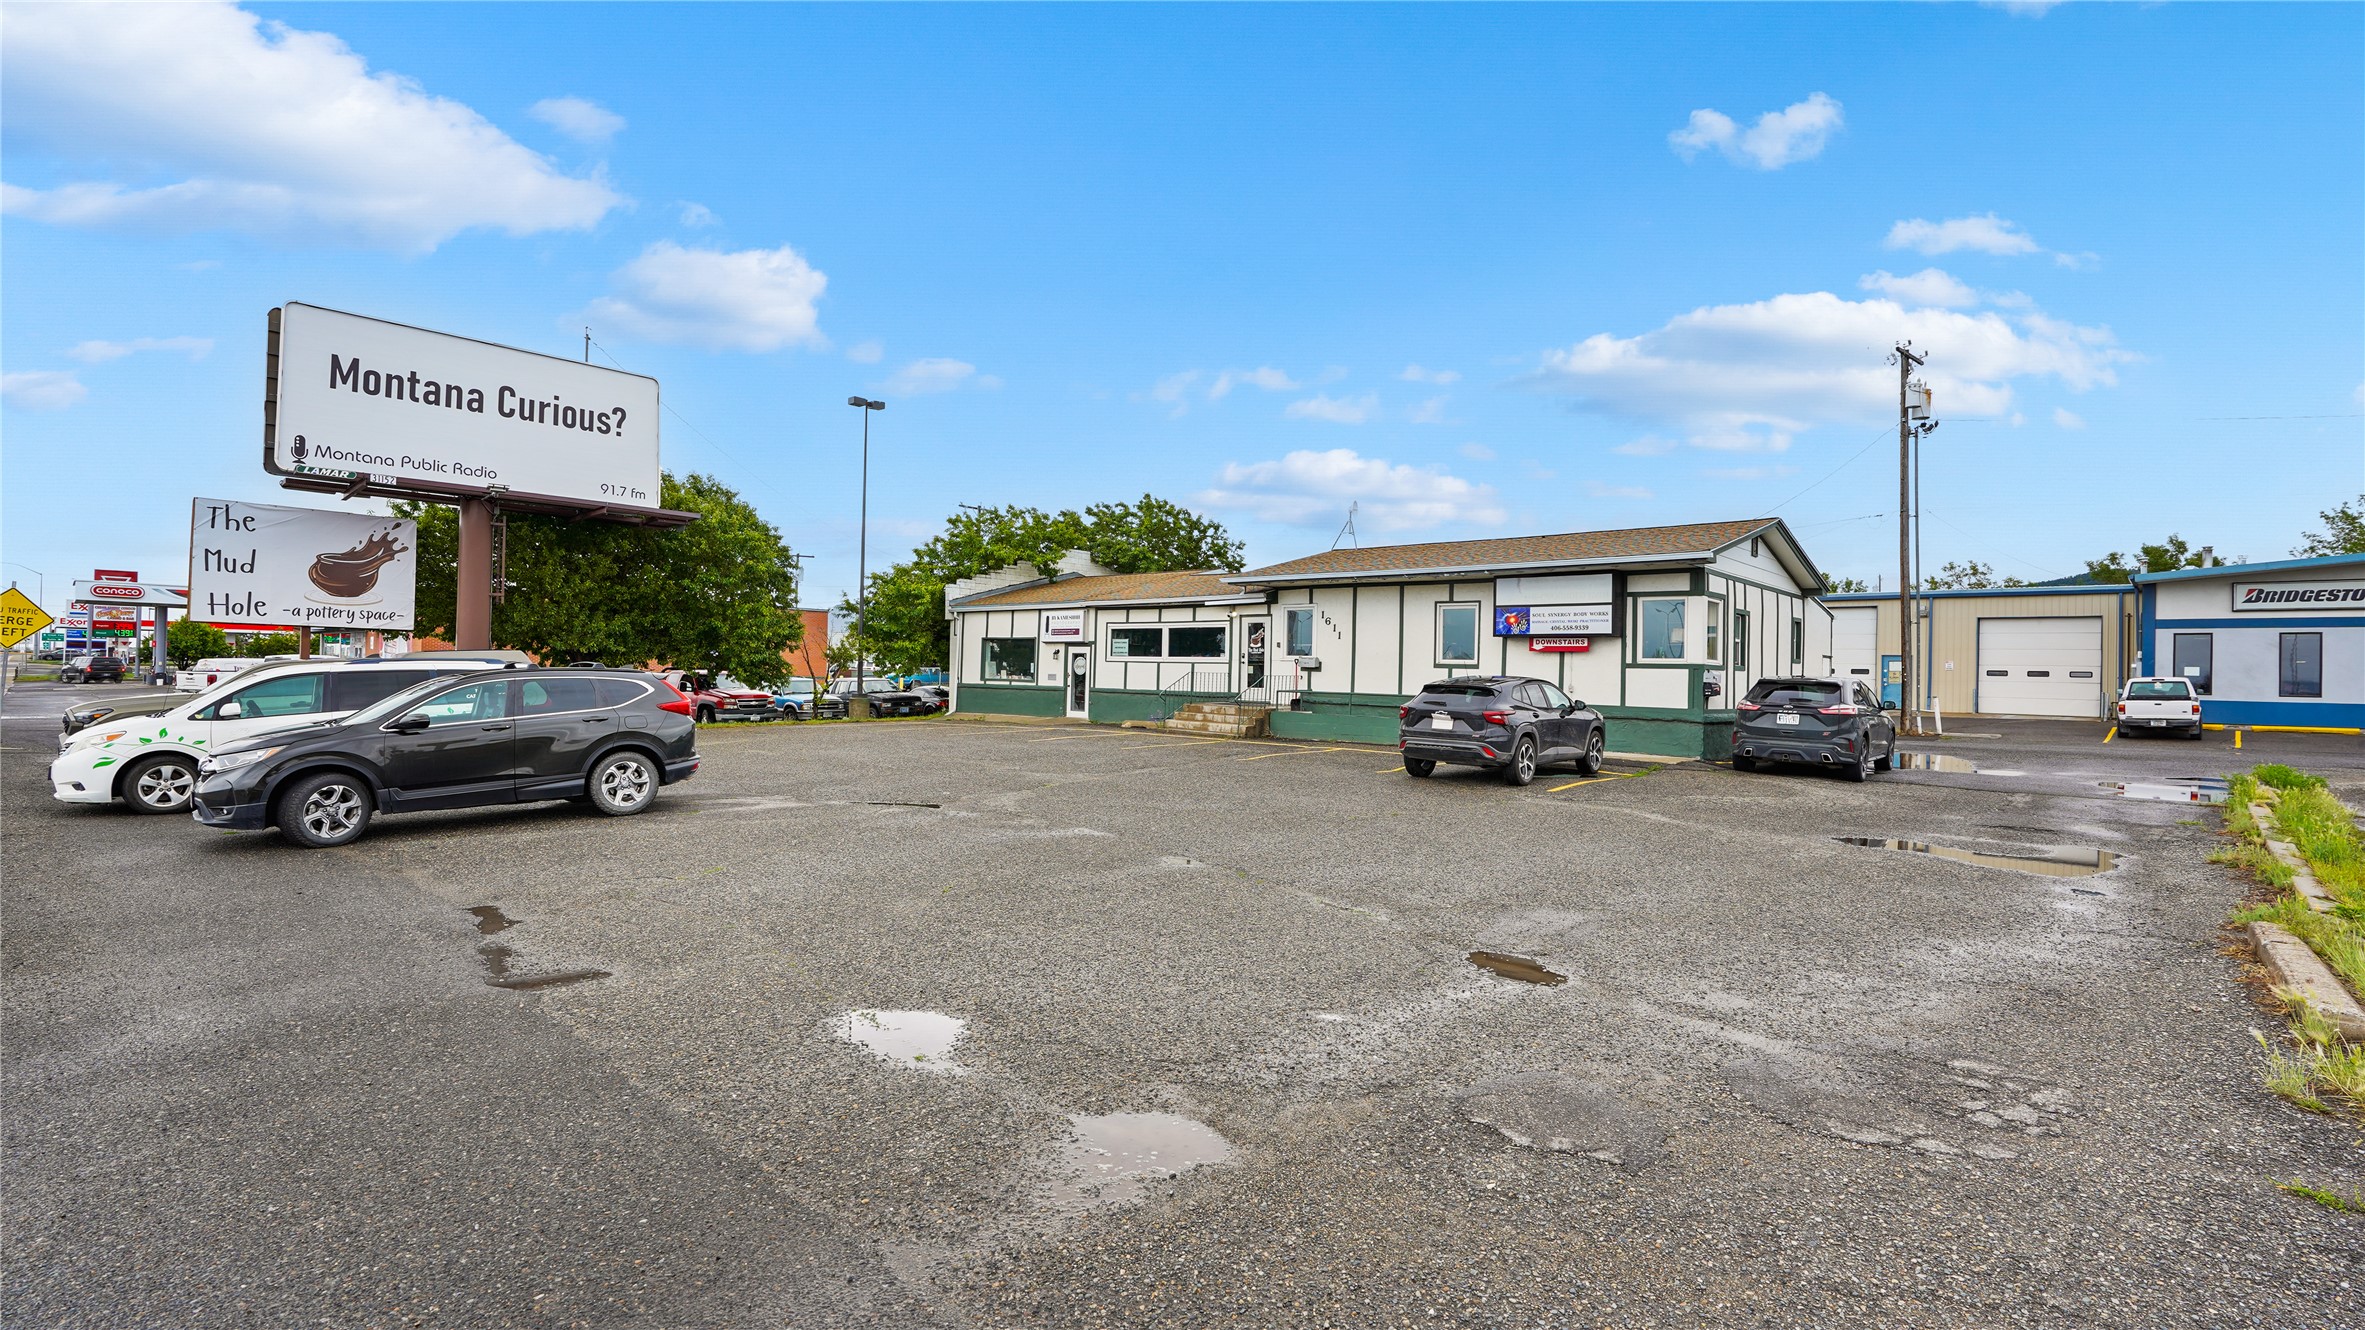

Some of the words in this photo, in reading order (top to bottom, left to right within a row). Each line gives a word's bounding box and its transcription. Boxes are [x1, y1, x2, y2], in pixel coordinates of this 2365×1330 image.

[329, 353, 485, 414] Montana
[498, 385, 627, 437] Curious?
[314, 444, 395, 467] Montana
[401, 455, 447, 473] Public
[453, 462, 498, 479] Radio
[303, 466, 350, 479] LAMAR
[372, 474, 395, 484] 31152
[600, 483, 627, 496] 91.7
[631, 488, 646, 499] fm
[207, 504, 257, 532] The
[204, 548, 257, 574] Mud
[207, 591, 268, 617] Hole
[2241, 588, 2365, 603] BRIDGESTO
[8, 607, 39, 615] TRAFFIC
[306, 606, 355, 624] pottery
[0, 616, 34, 626] ERGE
[1321, 610, 1341, 640] 1611
[2, 627, 27, 636] EFT
